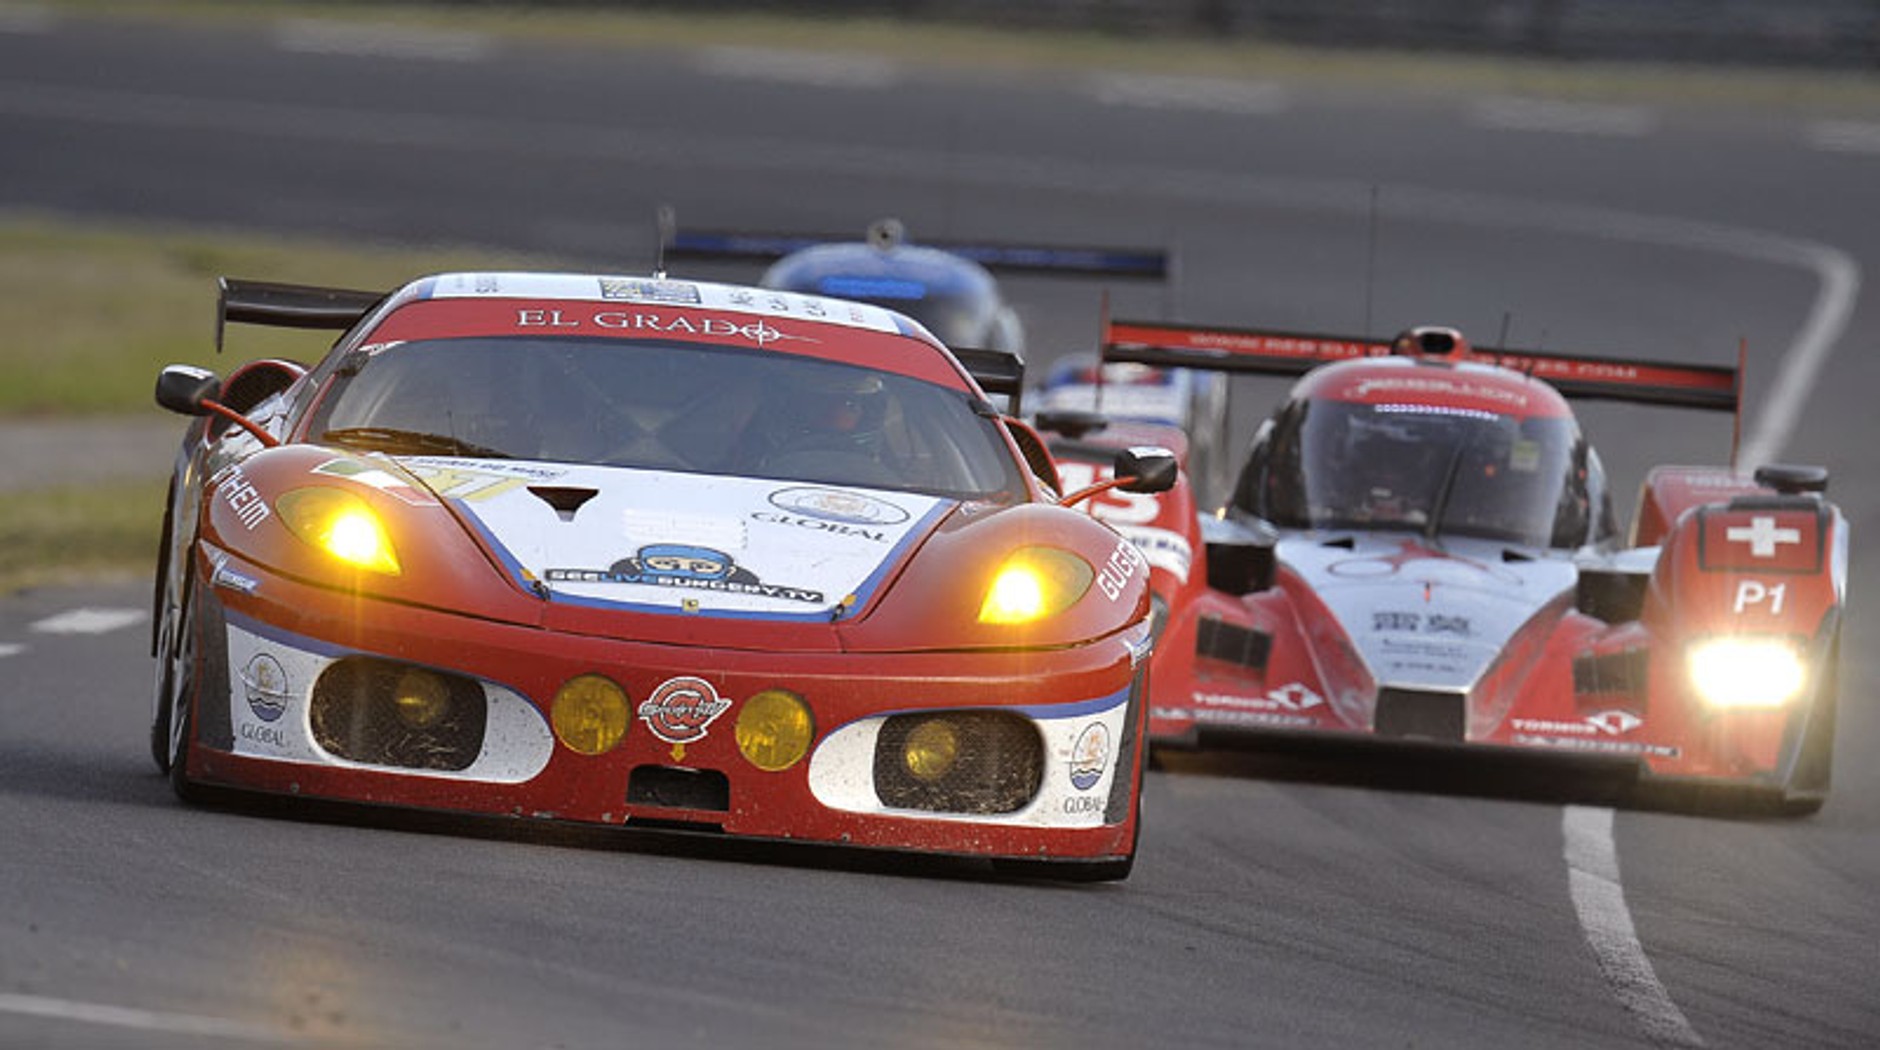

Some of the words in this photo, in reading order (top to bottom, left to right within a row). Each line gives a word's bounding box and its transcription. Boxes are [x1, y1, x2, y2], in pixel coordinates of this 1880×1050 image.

[517, 309, 579, 326] EL
[594, 312, 782, 346] GRADO
[751, 512, 889, 543] GLOBAL
[1733, 580, 1786, 615] P1
[241, 723, 286, 748] GLOBAL
